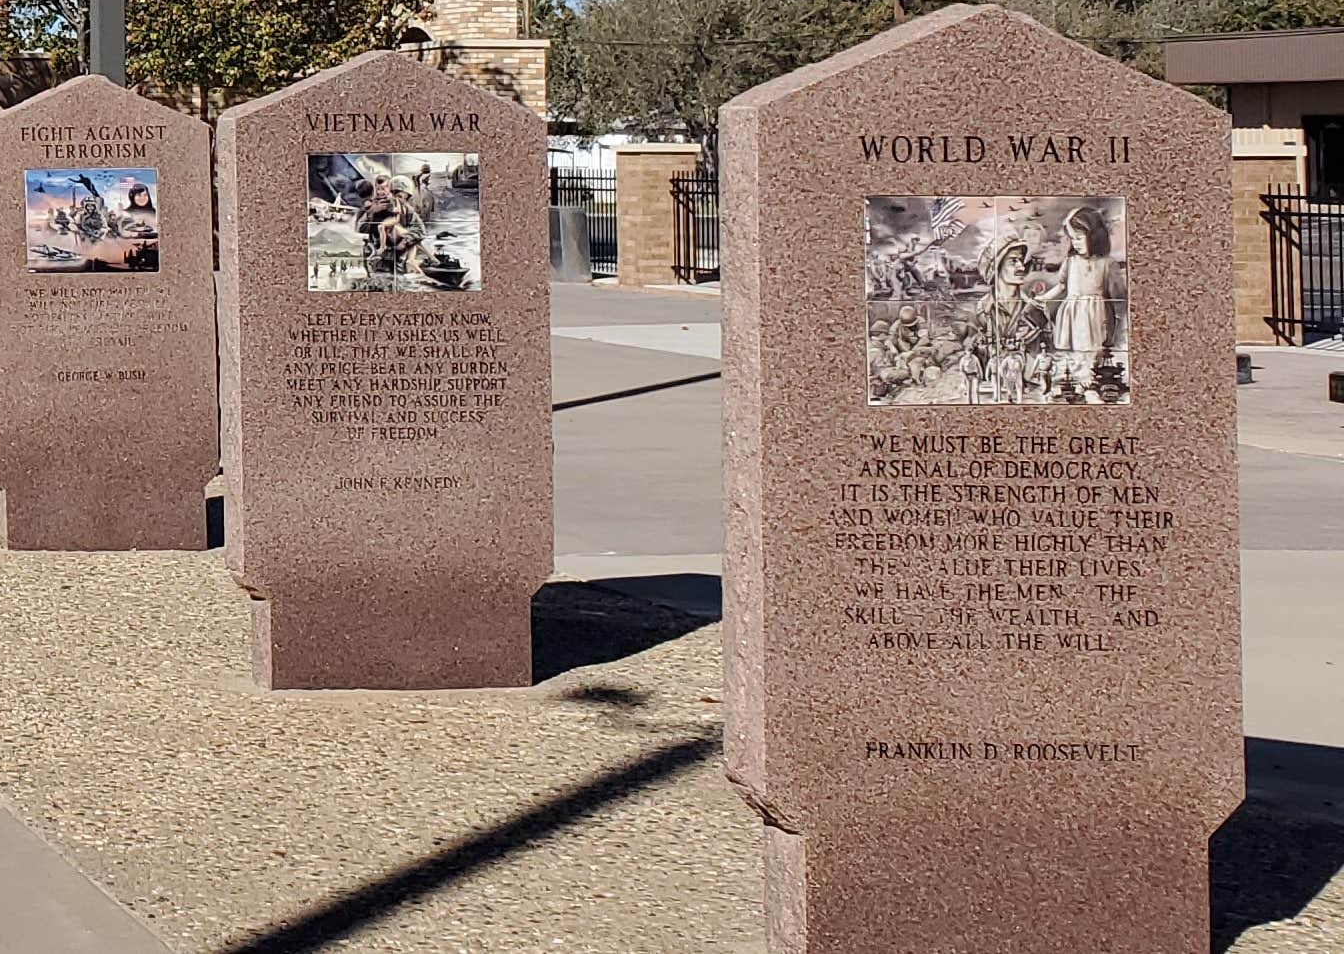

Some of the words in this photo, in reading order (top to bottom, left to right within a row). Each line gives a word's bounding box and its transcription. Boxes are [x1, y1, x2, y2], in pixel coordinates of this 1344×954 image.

[306, 113, 416, 132] VIETNAM
[429, 112, 481, 132] WAR
[20, 126, 75, 142] FIGHT
[85, 125, 167, 141] AGAINST
[40, 143, 146, 159] TERRORISM
[859, 135, 986, 164] WORLD
[1008, 135, 1087, 164] WAR
[1109, 135, 1131, 164] II
[341, 312, 386, 326] EVERY
[392, 312, 443, 326] NATION
[288, 329, 357, 342] WHETHER
[365, 329, 378, 342] IT
[385, 329, 436, 342] WISHES
[443, 329, 459, 342] US
[466, 329, 504, 342] WELL
[294, 346, 312, 359] OR
[352, 346, 389, 359] THAT
[397, 346, 416, 359] WE
[424, 346, 471, 359] SHALL
[475, 346, 497, 359] PAY
[284, 362, 313, 375] ANY
[371, 362, 405, 375] BEAR
[414, 362, 443, 375] ANY
[287, 378, 325, 391] MEET
[332, 378, 362, 391] ANY
[447, 378, 506, 391] SUPPORT
[293, 395, 323, 408] ANY
[331, 395, 382, 408] FRIEND
[389, 395, 406, 408] TO
[414, 395, 466, 408] ASSURE
[474, 395, 502, 408] THE
[387, 410, 417, 424] AND
[424, 410, 485, 424] SUCCESS
[912, 436, 969, 454] MUST
[981, 436, 1003, 454] BE
[1016, 436, 1058, 454] THE
[1069, 436, 1140, 455] GREAT
[859, 460, 958, 479] ARSENAL
[969, 460, 996, 479] OF
[335, 476, 373, 490] JOHN
[393, 476, 461, 490] KENNEDY
[841, 484, 862, 504] IT
[872, 484, 889, 504] IS
[900, 484, 943, 504] THE
[953, 484, 1065, 504] STRENGTH
[1077, 484, 1103, 504] OF
[1113, 484, 1159, 504] MEN
[829, 508, 873, 527] AND
[972, 508, 1020, 527] WHO
[1032, 510, 1099, 528] VALUE
[1110, 511, 1174, 529] THEIR
[835, 533, 935, 551] FREEDOM
[946, 533, 1002, 551] MORE
[1014, 534, 1092, 552] HIGHLY
[1104, 535, 1167, 553] THAN
[1004, 558, 1068, 577] THEIR
[1095, 585, 1138, 602] THE
[1112, 609, 1161, 627] AND
[868, 633, 938, 651] ABOVE
[1002, 633, 1046, 651] THE
[866, 741, 973, 762] FRANKLIN
[1012, 741, 1140, 762] ROOSEVELT
